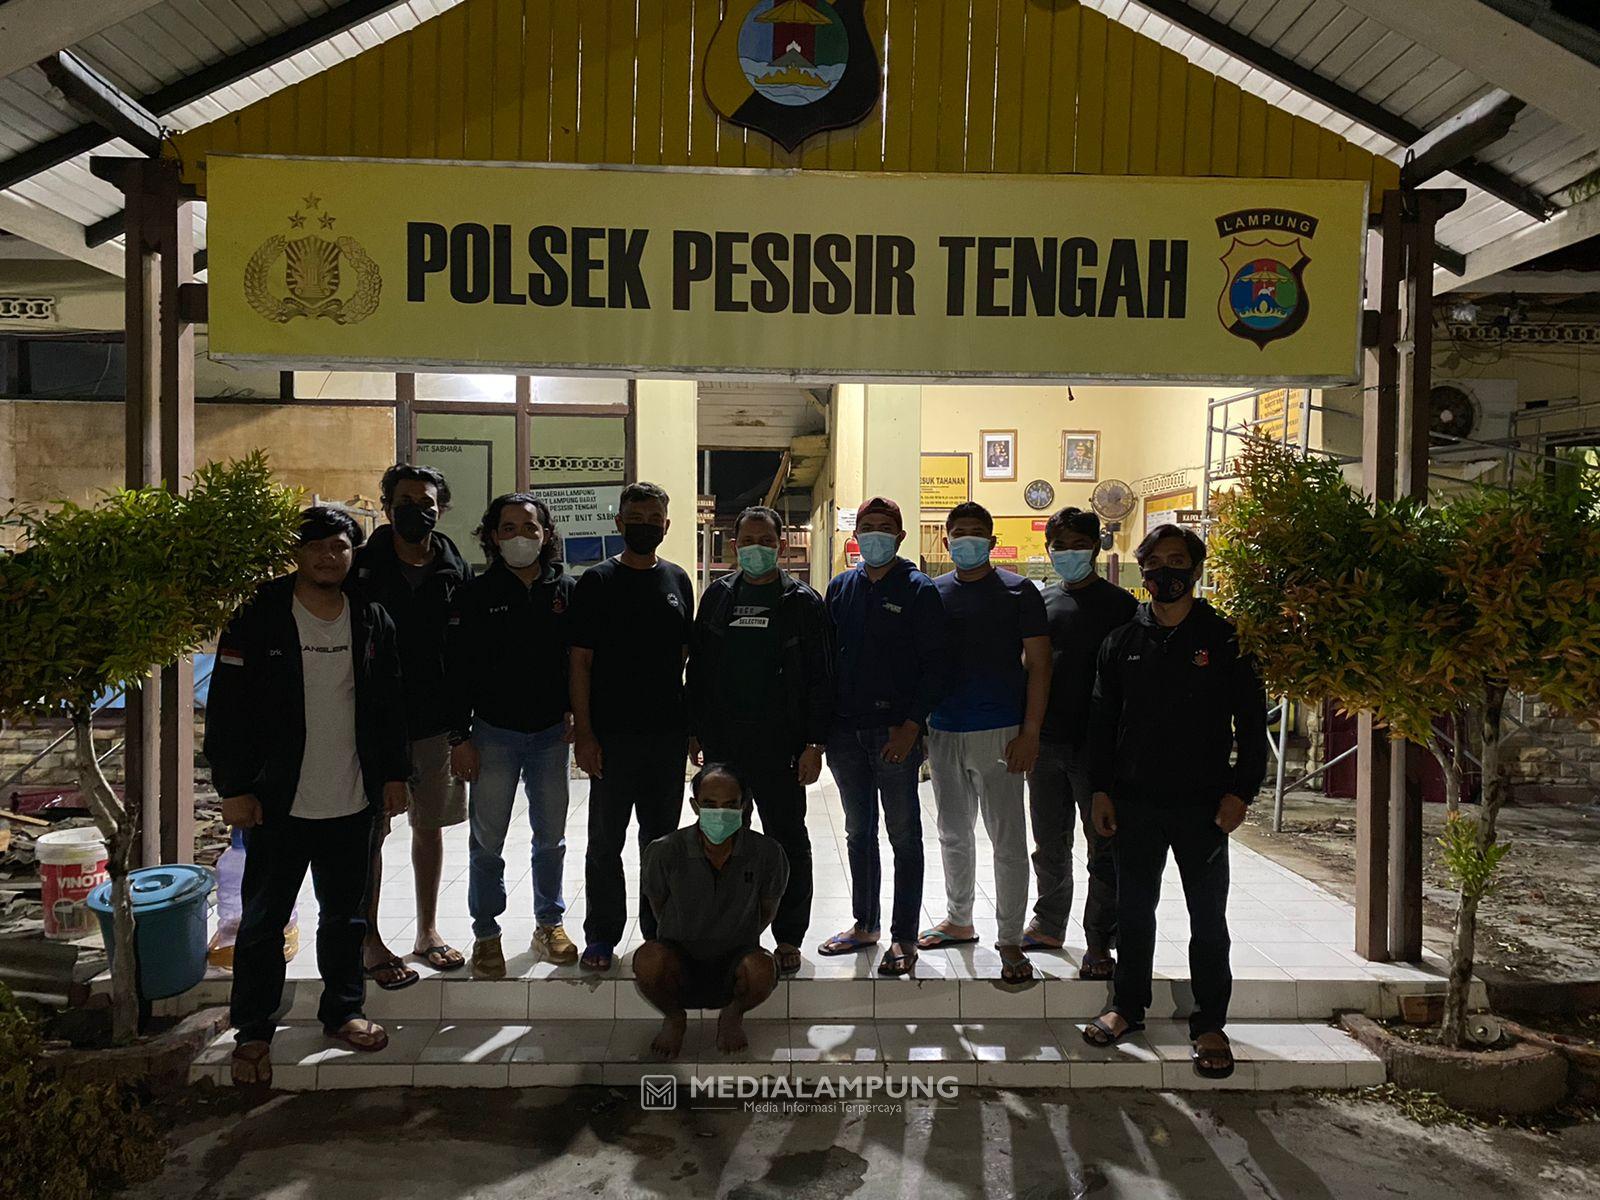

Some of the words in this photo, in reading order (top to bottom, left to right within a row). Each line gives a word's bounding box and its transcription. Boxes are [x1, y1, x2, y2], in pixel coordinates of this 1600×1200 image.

[1223, 214, 1311, 232] LAMPUNG
[407, 222, 649, 308] POLSEK
[673, 230, 914, 315] PESISIR
[939, 236, 1187, 318] TENGAH
[936, 476, 965, 485] TAHANAN
[301, 645, 348, 653] ANGLER
